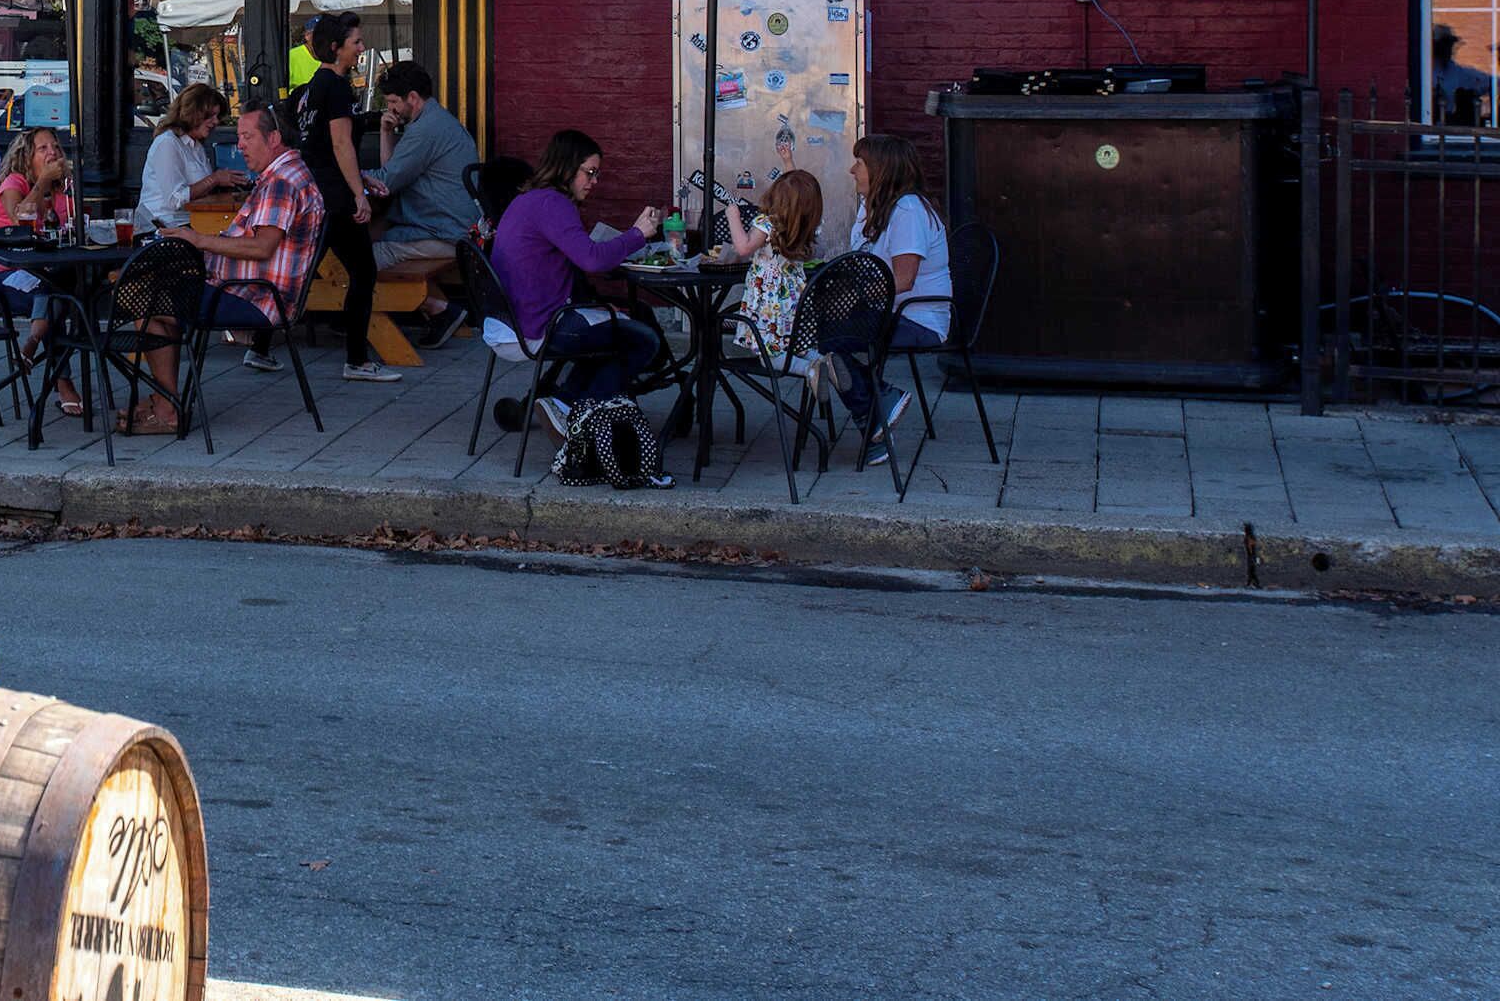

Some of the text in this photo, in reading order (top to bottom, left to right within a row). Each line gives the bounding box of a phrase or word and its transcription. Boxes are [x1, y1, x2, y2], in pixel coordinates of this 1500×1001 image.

[109, 815, 170, 916] Ale
[71, 911, 176, 963] BOURBON BARREL
